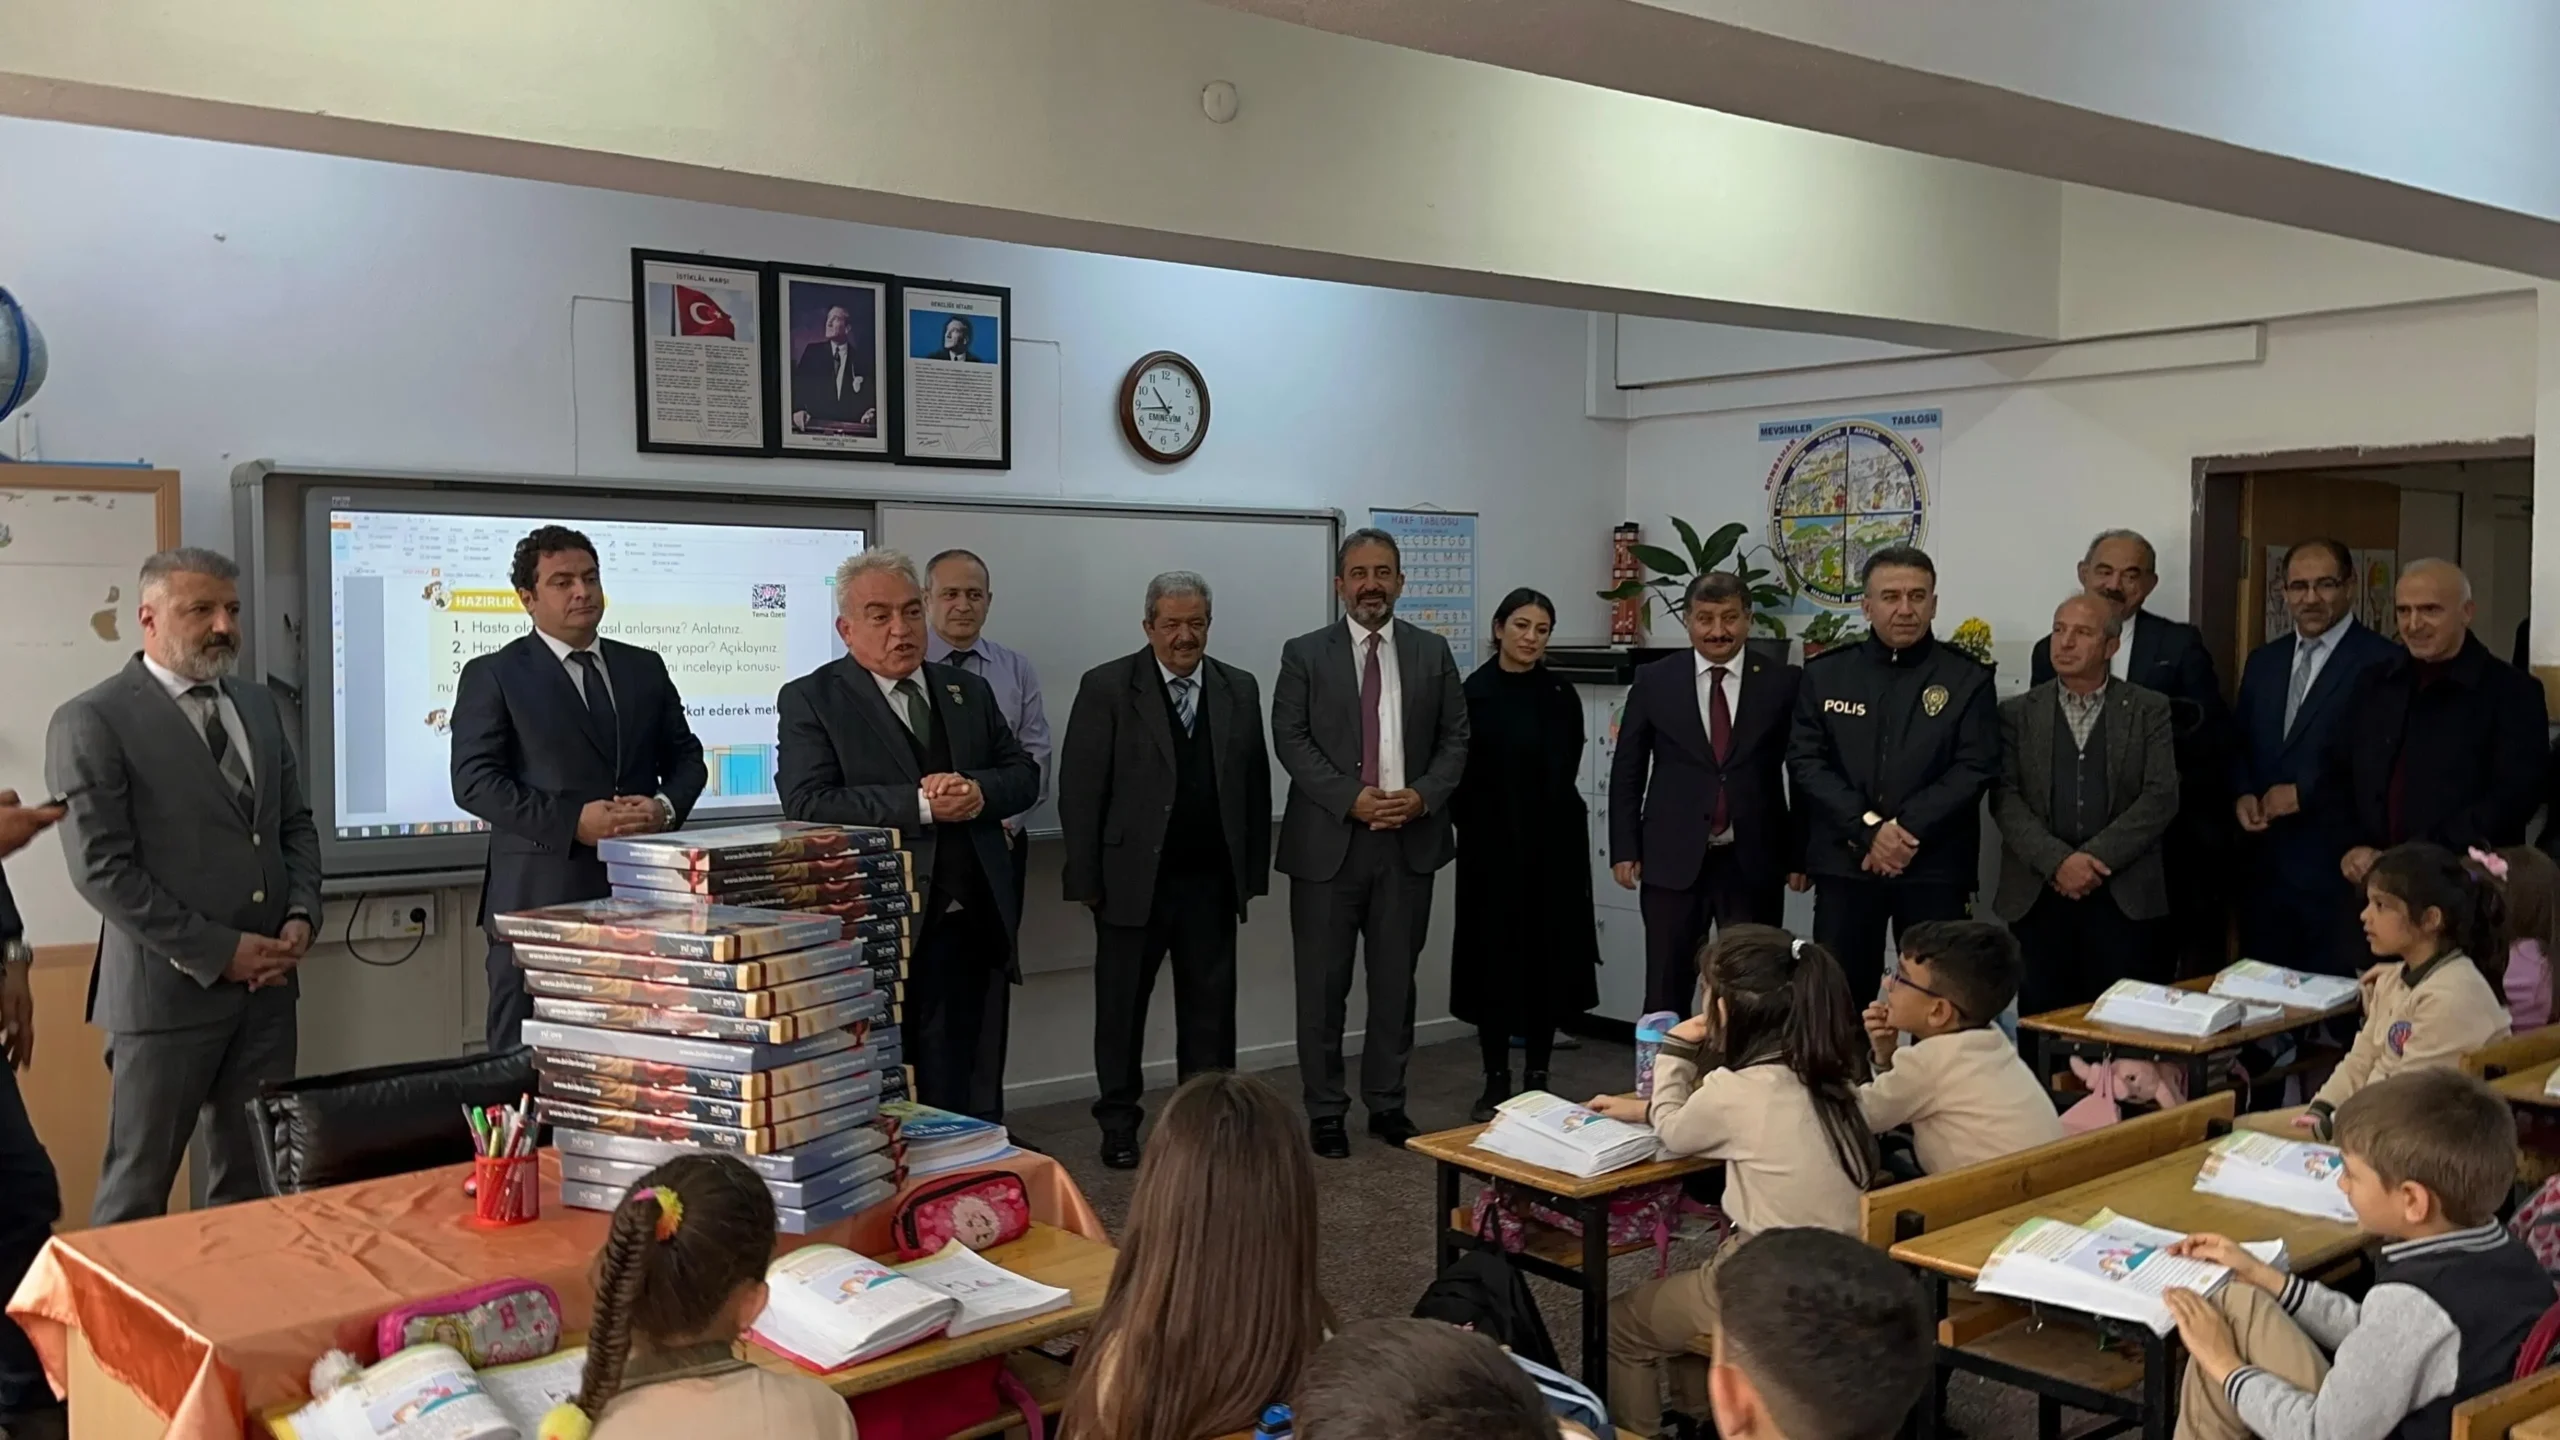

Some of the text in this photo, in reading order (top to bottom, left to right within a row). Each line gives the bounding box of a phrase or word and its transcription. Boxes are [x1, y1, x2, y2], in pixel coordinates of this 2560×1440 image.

[1149, 374, 1156, 384] 11
[1161, 370, 1171, 380] 12
[1177, 377, 1180, 387] 1
[1138, 386, 1148, 396] 10
[1185, 388, 1191, 398] 2
[1135, 399, 1141, 410] 9
[1188, 406, 1194, 416] 3
[1138, 416, 1144, 427] 8
[1891, 413, 1937, 425] TABLOSU
[1184, 422, 1190, 432] 4
[1147, 430, 1153, 440] 7
[1174, 433, 1180, 442] 5
[1854, 427, 1880, 439] ARALIK
[1160, 436, 1166, 445] 6
[1764, 439, 1796, 491] SONBAHAR
[1391, 516, 1459, 526] HARF TABLOSU
[455, 595, 515, 608] HAZIRLIK
[453, 620, 465, 634] 1.
[472, 620, 510, 634] Hasta
[625, 621, 688, 634] anlarsınız?
[691, 623, 743, 635] Anlatınız.
[452, 641, 466, 654] 2.
[677, 642, 716, 656] yapar?
[683, 661, 732, 675] inceleyip
[709, 702, 750, 716] ederek
